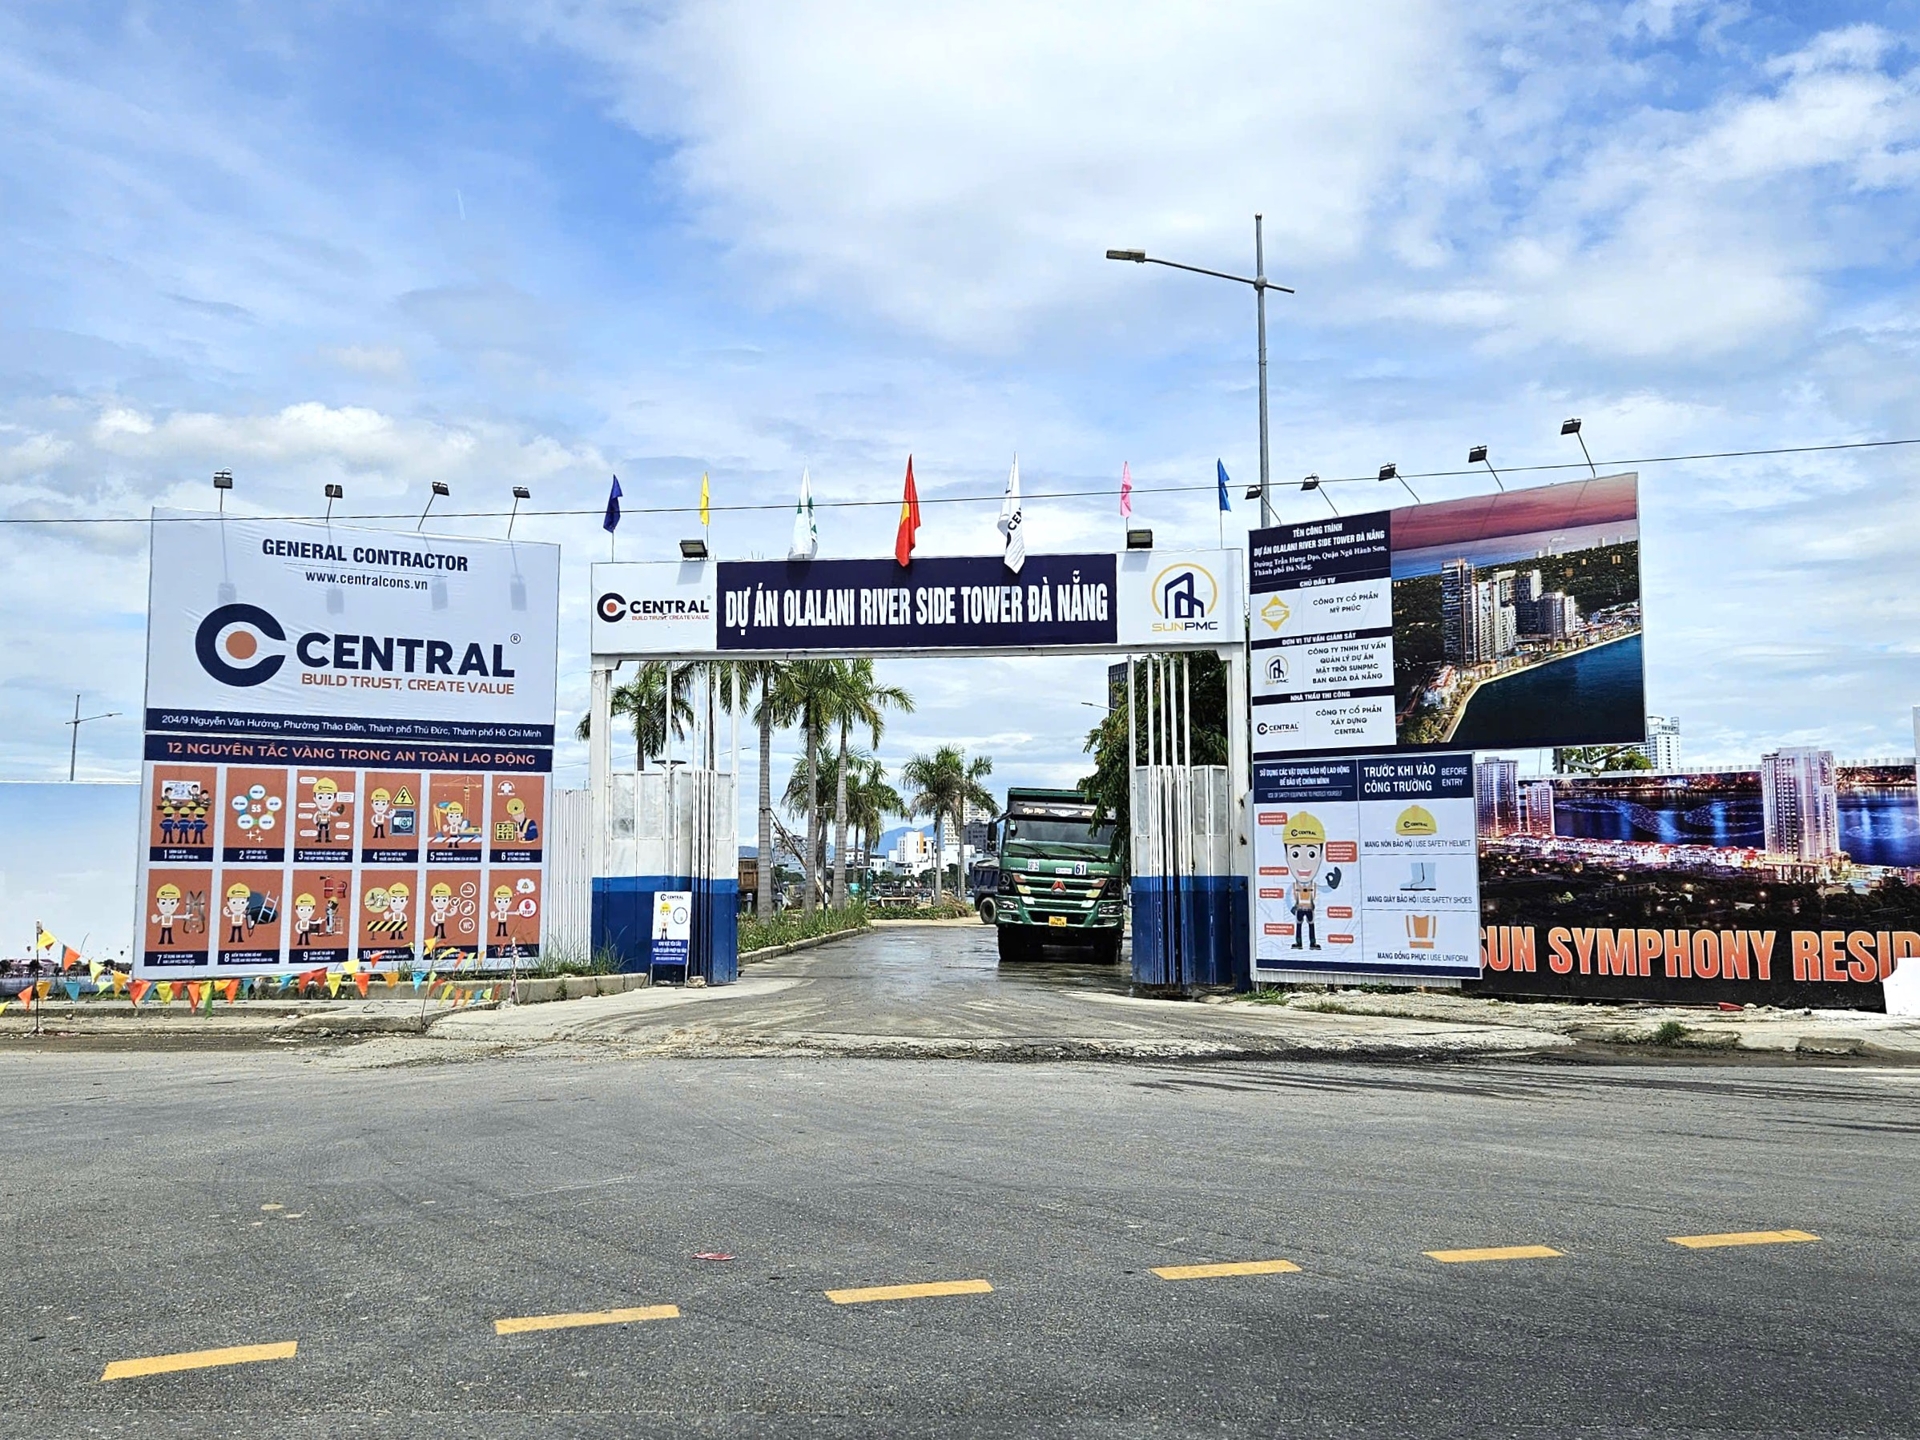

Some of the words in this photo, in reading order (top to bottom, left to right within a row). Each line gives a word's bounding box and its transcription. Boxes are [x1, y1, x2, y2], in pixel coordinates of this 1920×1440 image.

[1306, 525, 1322, 536] CÔNG
[1298, 540, 1316, 550] RIVER
[1318, 538, 1332, 548] SIDE
[1333, 534, 1354, 546] TOWER
[1356, 532, 1365, 542] ĐÀ
[262, 538, 347, 562] GENERAL
[352, 547, 468, 572] CONTRACTOR
[1254, 568, 1272, 577] Thành
[305, 571, 428, 590] www.centralcons.vn
[725, 586, 750, 636] DỰ
[754, 582, 779, 628] ÁN
[783, 588, 855, 628] OLALANI
[860, 586, 911, 626] RIVER
[915, 585, 956, 626] SIDE
[960, 584, 1023, 625] TOWER
[1027, 577, 1052, 623] ĐÀ
[1056, 570, 1108, 622] NẴNG
[1313, 596, 1334, 606] CÔNG
[630, 600, 710, 614] CENTRAL
[1342, 604, 1362, 612] PHÚC
[1151, 620, 1218, 632] SUNPMC
[1308, 648, 1329, 656] CÔNG
[1360, 644, 1370, 652] TƯ
[1372, 640, 1387, 650] VẤN
[296, 632, 516, 678] CENTRAL
[1352, 654, 1362, 663] DỰ
[1363, 652, 1374, 660] ÁN
[1349, 662, 1379, 671] SUNPMC
[301, 672, 348, 687] BUILD
[351, 675, 402, 692] TRUST,
[407, 678, 465, 693] CREATE
[467, 682, 515, 695] VALUE
[1312, 676, 1327, 684] BAN
[1349, 673, 1360, 682] ĐÀ
[1316, 708, 1338, 717] CÔNG
[161, 714, 189, 724] 204/9
[190, 716, 226, 727] Nguyễn
[227, 717, 245, 726] Văn
[284, 720, 320, 732] Phường
[368, 724, 394, 733] Thành
[396, 724, 412, 735] phố
[430, 726, 450, 736] Đức,
[452, 726, 477, 736] Thành
[478, 727, 494, 738] phố
[495, 727, 506, 737] Hồ
[508, 728, 522, 737] Chí
[522, 729, 542, 738] Minh
[1330, 718, 1345, 726] XÂY
[1346, 717, 1368, 726] DỰNG
[1268, 722, 1299, 732] CENTRAL
[1334, 727, 1364, 736] CENTRAL
[167, 742, 183, 754] 12
[186, 741, 254, 756] NGUYÊN
[258, 742, 288, 758] TẮC
[292, 744, 336, 760] VÀNG
[338, 748, 391, 762] TRONG
[394, 751, 416, 762] AN
[419, 748, 459, 764] TOÀN
[462, 752, 492, 764] LAO
[494, 752, 536, 767] ĐỘNG
[1364, 763, 1395, 778] TRƯỚC
[1397, 765, 1414, 776] KHI
[1415, 762, 1436, 776] VÀO
[1441, 766, 1468, 776] BEFORE
[1364, 779, 1390, 793] CÔNG
[1392, 777, 1432, 792] TRƯỜNG
[1442, 778, 1464, 786] ENTRY
[1449, 839, 1471, 847] HELMET
[239, 850, 245, 860] 2
[298, 850, 304, 860] 3
[372, 850, 378, 860] 4
[430, 851, 435, 860] 5
[501, 850, 506, 860] 6
[1075, 864, 1085, 874] 61
[224, 952, 230, 962] 8
[302, 951, 309, 961] 9
[1377, 952, 1392, 960] MANG
[1480, 925, 1537, 973] UN
[1548, 926, 1777, 981] SYMPHONY
[156, 954, 162, 964] 7
